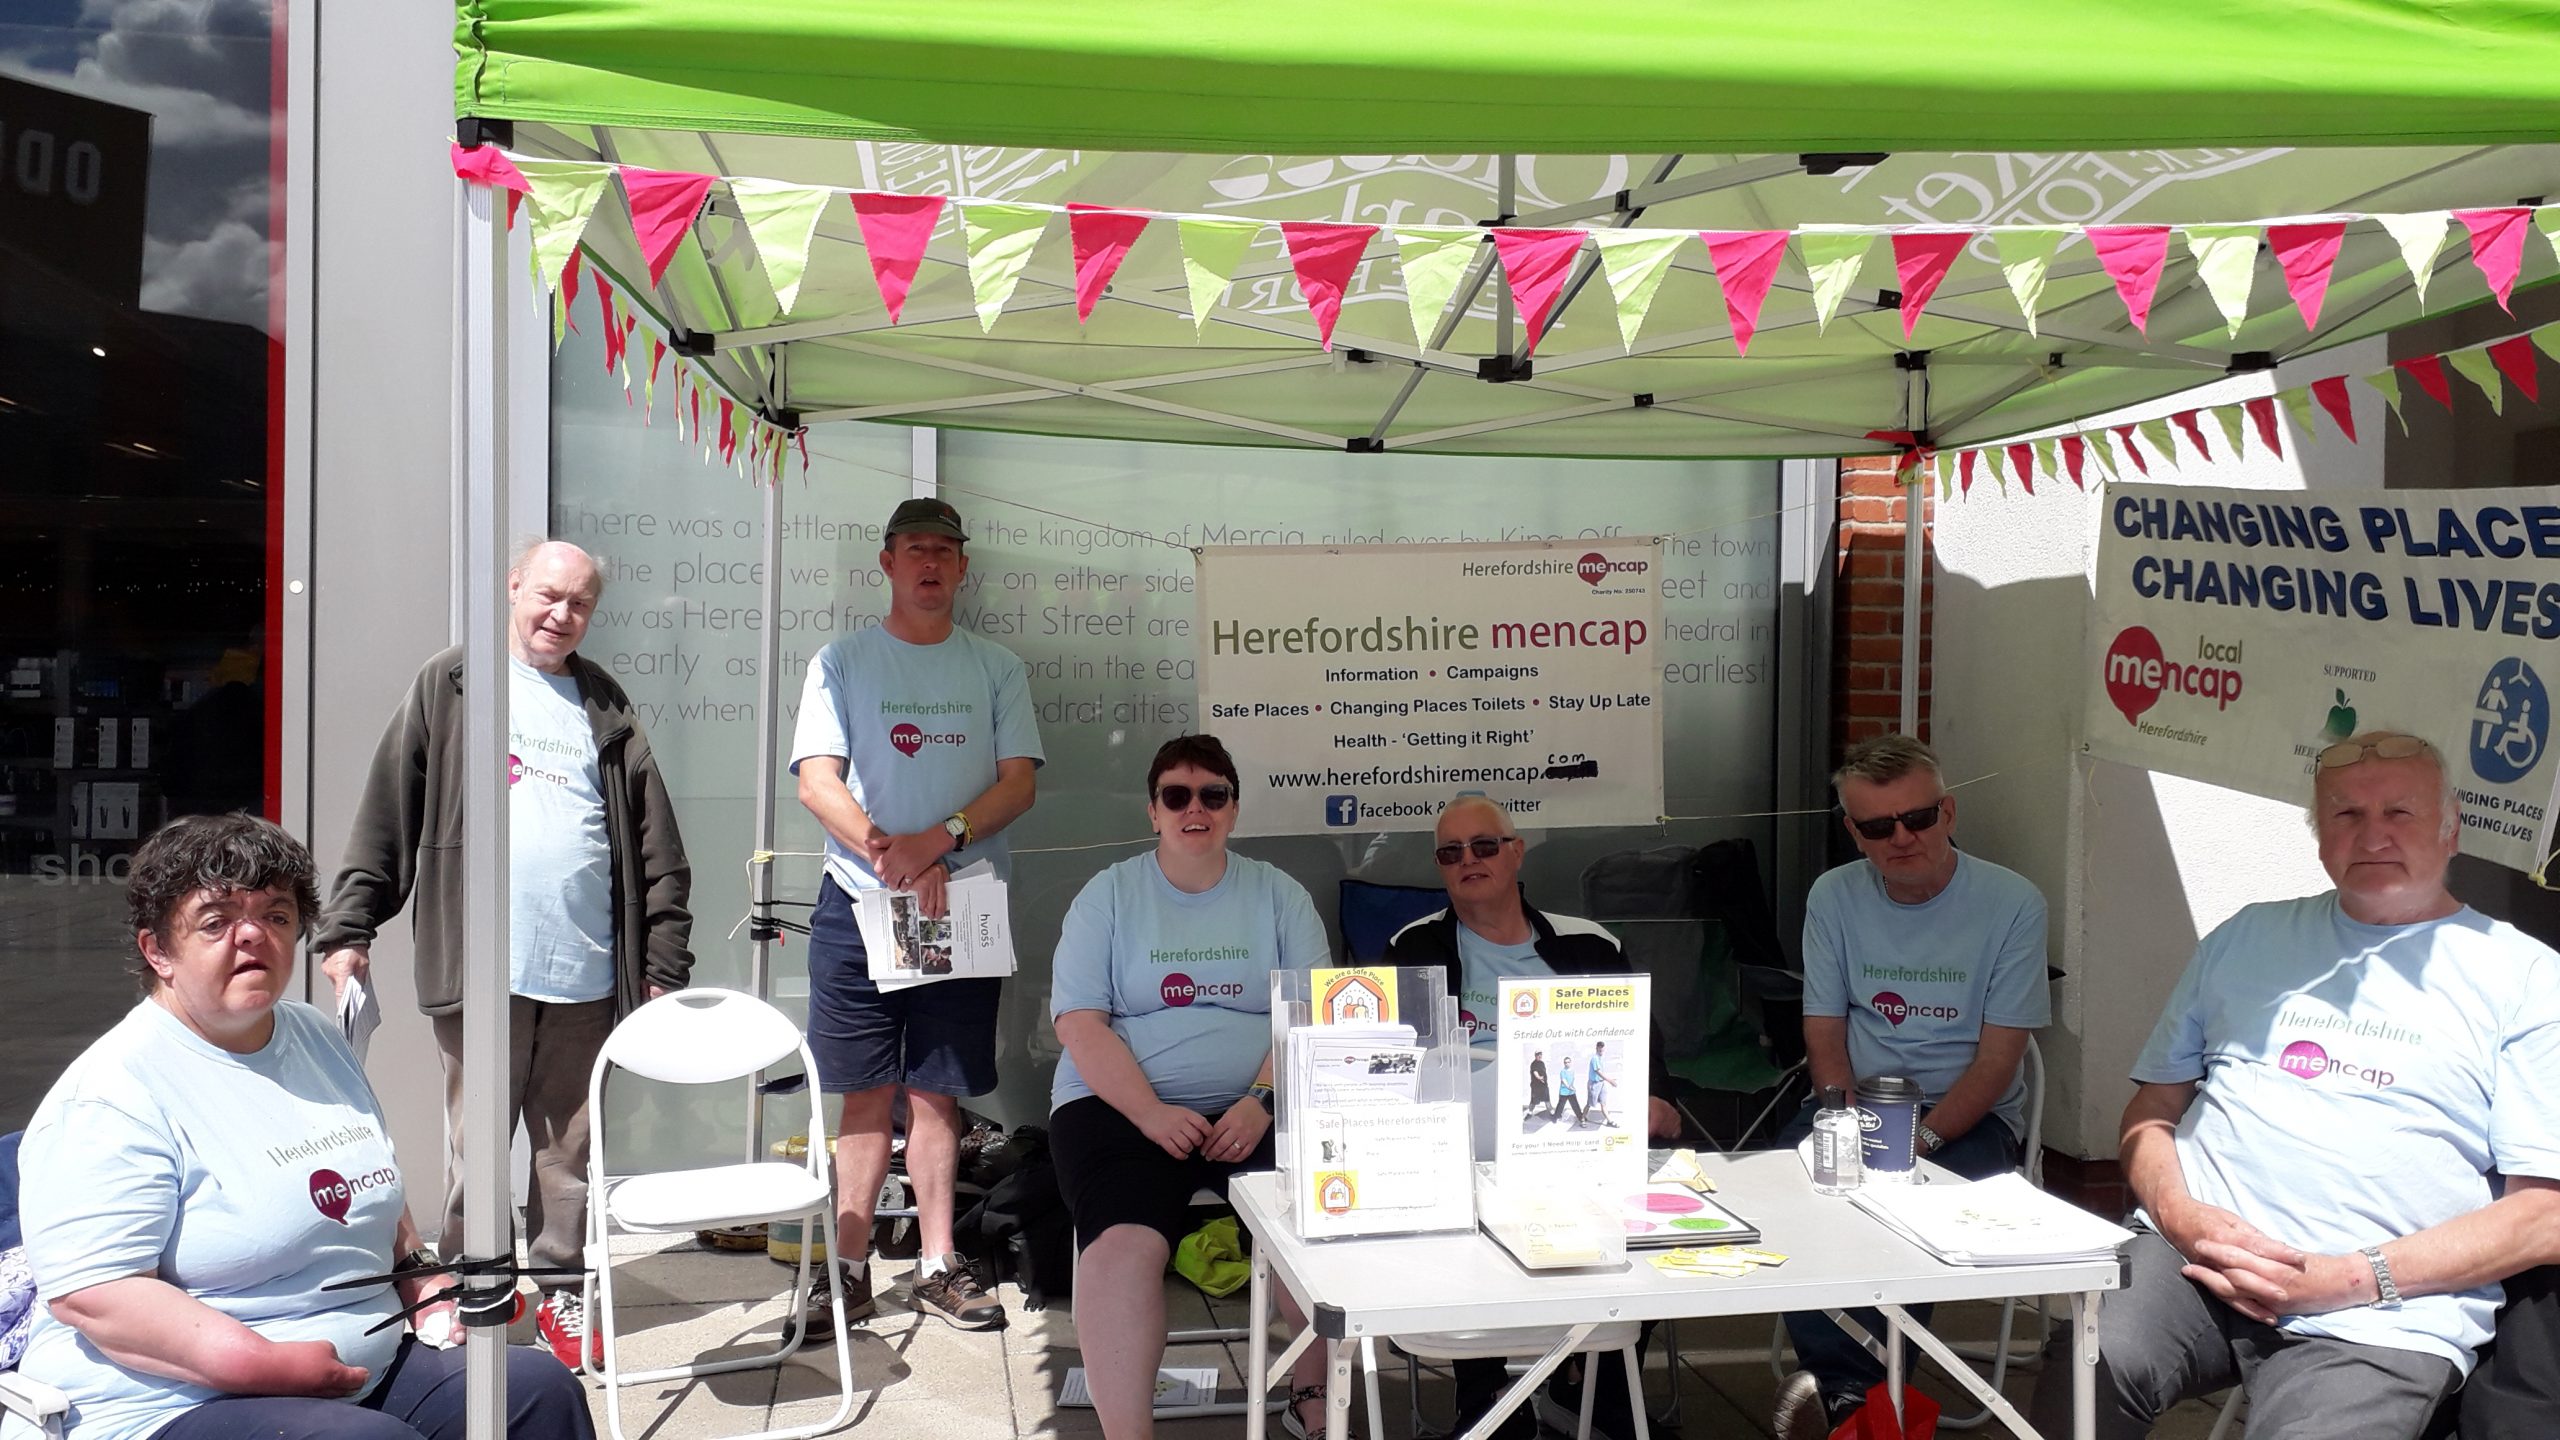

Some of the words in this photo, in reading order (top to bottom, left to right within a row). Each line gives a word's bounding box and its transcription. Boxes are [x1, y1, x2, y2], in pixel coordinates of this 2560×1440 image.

[668, 518, 723, 539] was
[733, 519, 751, 539] a
[780, 514, 886, 542] ettleme
[984, 519, 1028, 545] the
[1039, 521, 1154, 555] kingdom
[1164, 523, 1192, 549] of
[1202, 522, 1305, 546] Mercia
[1712, 533, 1772, 557] town
[2113, 496, 2350, 553] CHANGING
[606, 556, 652, 583] the
[674, 552, 764, 593] place
[790, 566, 829, 587] we
[849, 567, 884, 588] no
[1003, 571, 1037, 592] on
[1054, 567, 1129, 592] either
[1145, 567, 1196, 593] side
[1723, 577, 1771, 600] and
[1462, 559, 1574, 577] Herefordshire
[1579, 561, 1649, 575] mencap
[1591, 588, 1613, 596] Charity
[2132, 556, 2389, 621] CHANGING
[2403, 576, 2560, 640] LIVES
[642, 610, 673, 630] as
[683, 600, 835, 632] Hereord
[957, 604, 1028, 634] West
[1042, 605, 1136, 637] Street
[1147, 618, 1190, 637] are
[1750, 619, 1771, 642] in
[1212, 615, 1480, 656] Herefordshire
[1491, 618, 1648, 655] mencap
[2198, 635, 2243, 665] local
[612, 643, 700, 686] early
[725, 656, 757, 677] as
[1072, 655, 1093, 680] in
[1104, 655, 1145, 680] the
[1663, 655, 1767, 685] earliest
[1325, 668, 1419, 683] Information
[1446, 665, 1540, 682] Campaigns
[2322, 664, 2377, 683] SUPPORTED
[2108, 652, 2243, 711] mencap
[678, 695, 755, 722] when
[1113, 694, 1190, 725] cities
[881, 701, 973, 715] Herefordshire
[1212, 704, 1249, 719] Safe
[1254, 703, 1310, 717] Places
[1330, 700, 1409, 717] Changing
[1413, 699, 1468, 713] Places
[1472, 697, 1526, 711] Toilets
[1549, 695, 1585, 712] Stay
[1589, 694, 1613, 711] Up
[1617, 692, 1651, 708] Late
[509, 731, 583, 758] efordshire
[893, 732, 966, 747] mencap
[1334, 734, 1387, 748] Health
[1471, 731, 1482, 745] it
[2138, 720, 2208, 747] Herefordshire
[510, 763, 568, 786] encap
[1360, 801, 1433, 818] facebook
[2504, 799, 2544, 821] PLACES
[2502, 822, 2533, 842] LIVES
[38, 843, 132, 886] sho
[979, 913, 991, 949] hvoss
[1150, 946, 1250, 964] Herefordshire
[1324, 978, 1335, 988] We
[1335, 971, 1346, 979] are
[1352, 968, 1368, 976] Safe
[1368, 971, 1385, 986] Place
[1863, 964, 1967, 983] Herefordshire
[1163, 983, 1243, 998] mencap
[1555, 988, 1584, 998] Safe
[1587, 987, 1630, 997] Places
[1555, 1000, 1630, 1010] Herefordshire
[1874, 1001, 1959, 1021] mencap
[1513, 1030, 1544, 1040] Stride
[1545, 1029, 1562, 1039] Out
[1564, 1028, 1585, 1038] with
[1585, 1026, 1635, 1037] Confidence
[2279, 1010, 2423, 1046] Herefordshire
[2281, 1053, 2395, 1089] mencap
[266, 1124, 375, 1168] Herefordshire
[313, 1167, 396, 1207] mencap
